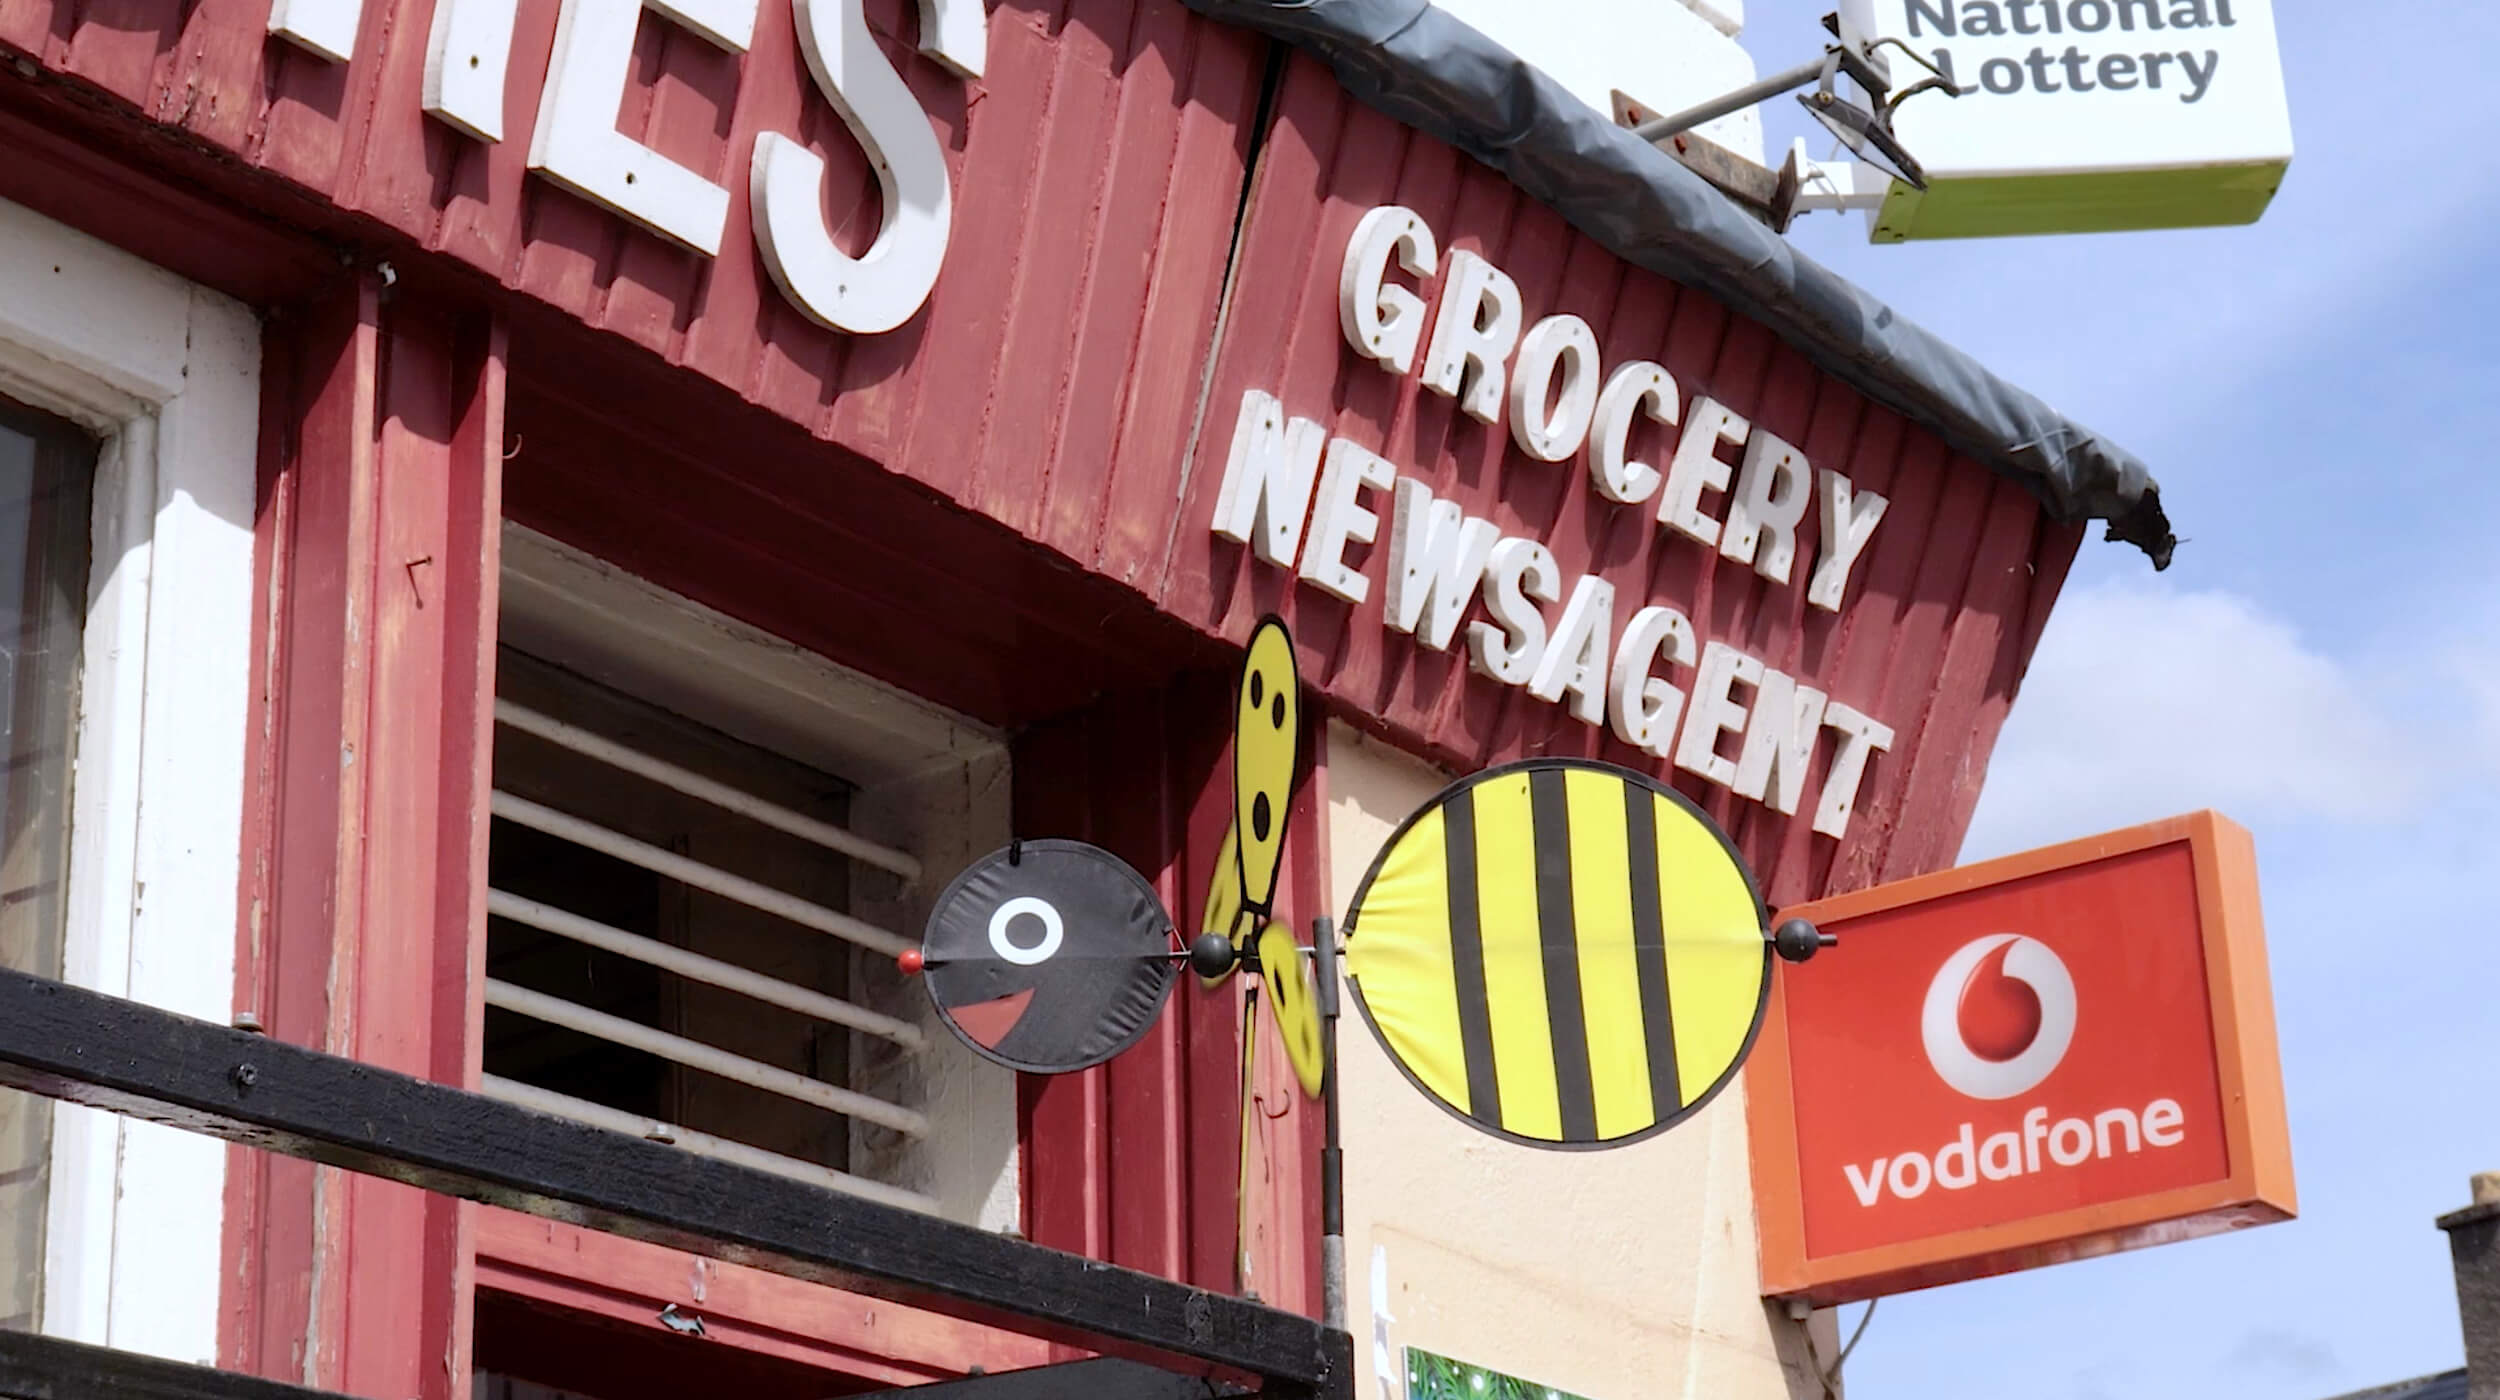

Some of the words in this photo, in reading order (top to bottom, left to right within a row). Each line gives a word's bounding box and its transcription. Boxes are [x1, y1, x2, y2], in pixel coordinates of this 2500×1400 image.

[1932, 46, 2219, 103] Lottery
[1339, 206, 1889, 612] GROCERY
[1212, 391, 1894, 839] NEWSAGENT
[1844, 1098, 2184, 1206] vodafone
